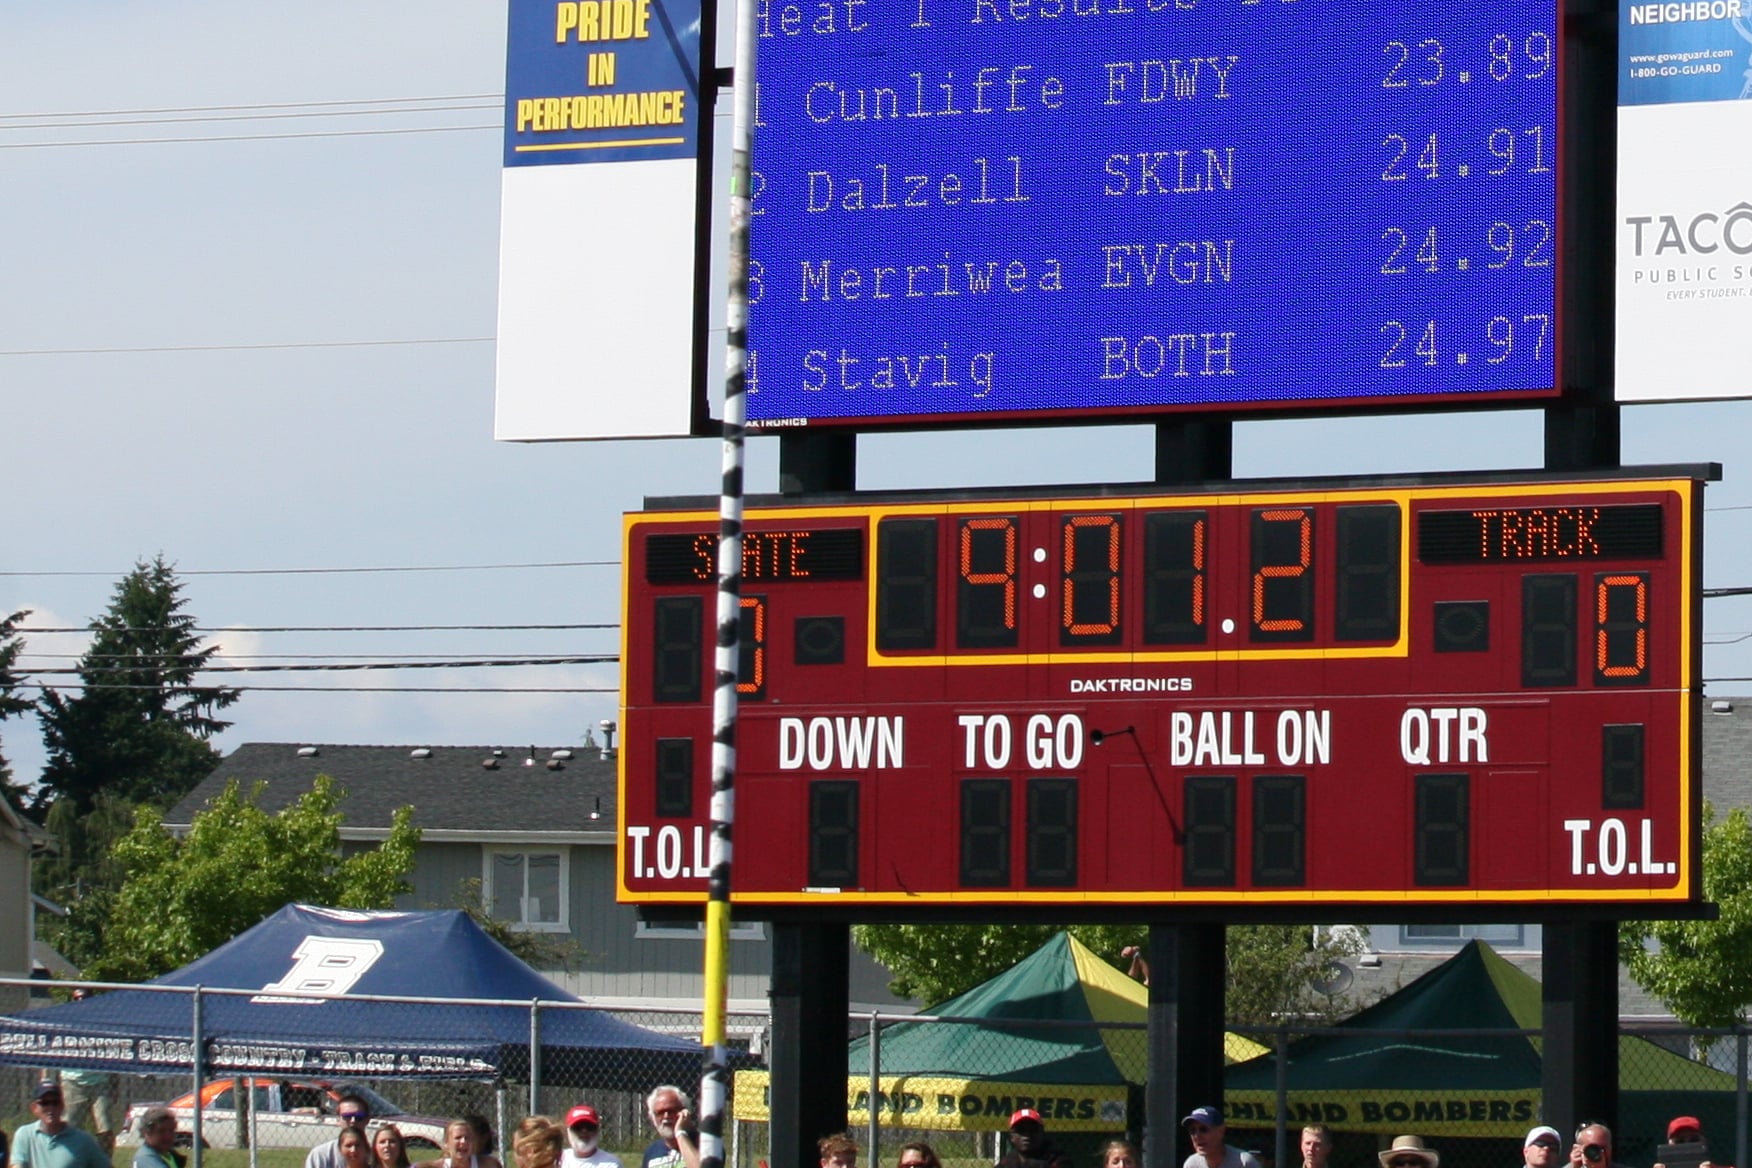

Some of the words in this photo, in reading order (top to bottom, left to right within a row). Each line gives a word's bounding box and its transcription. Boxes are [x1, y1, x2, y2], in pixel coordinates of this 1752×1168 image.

[1630, 0, 1742, 24] NEIGHBOR
[588, 52, 615, 86] IN
[806, 65, 1064, 123] Cunliffe
[1104, 55, 1240, 106] FDWY
[1383, 31, 1552, 88] 23.89
[1630, 49, 1733, 64] www.gowaguard.com
[1630, 63, 1722, 78] 1-800-GO-GUARD
[517, 90, 685, 132] PERFORMANCE
[751, 172, 767, 216] 2
[807, 155, 1032, 213] Dalzell
[1104, 147, 1237, 196] SKLN
[1382, 126, 1551, 181] 24.91
[799, 252, 1064, 302] Merriwea
[1100, 240, 1236, 288] EVGN
[1381, 219, 1550, 274] 24.92
[1635, 267, 1717, 283] PUBLIC
[1666, 289, 1697, 300] EVERY
[803, 342, 996, 398] Stavig
[1099, 331, 1237, 380] BOTH
[1379, 313, 1549, 368] 24.97
[745, 418, 807, 428] AKTRONICS
[693, 531, 811, 580] SATE
[1473, 508, 1599, 557] TRACK
[1597, 575, 1646, 677] 0
[1070, 678, 1193, 693] DAKTRONICS
[779, 716, 903, 770] DOWN
[958, 714, 1011, 769] TO
[1025, 714, 1083, 769] GO
[1171, 711, 1265, 766] BALL
[1277, 709, 1331, 765] ON
[1400, 707, 1489, 766] QTR
[1564, 818, 1676, 876] T.O.L.
[250, 934, 385, 1004] B
[208, 1044, 306, 1068] COUNTRY
[322, 1050, 395, 1071] TRACK
[937, 1093, 1096, 1120] BOMBERS
[1362, 1099, 1532, 1123] BOMBERS
